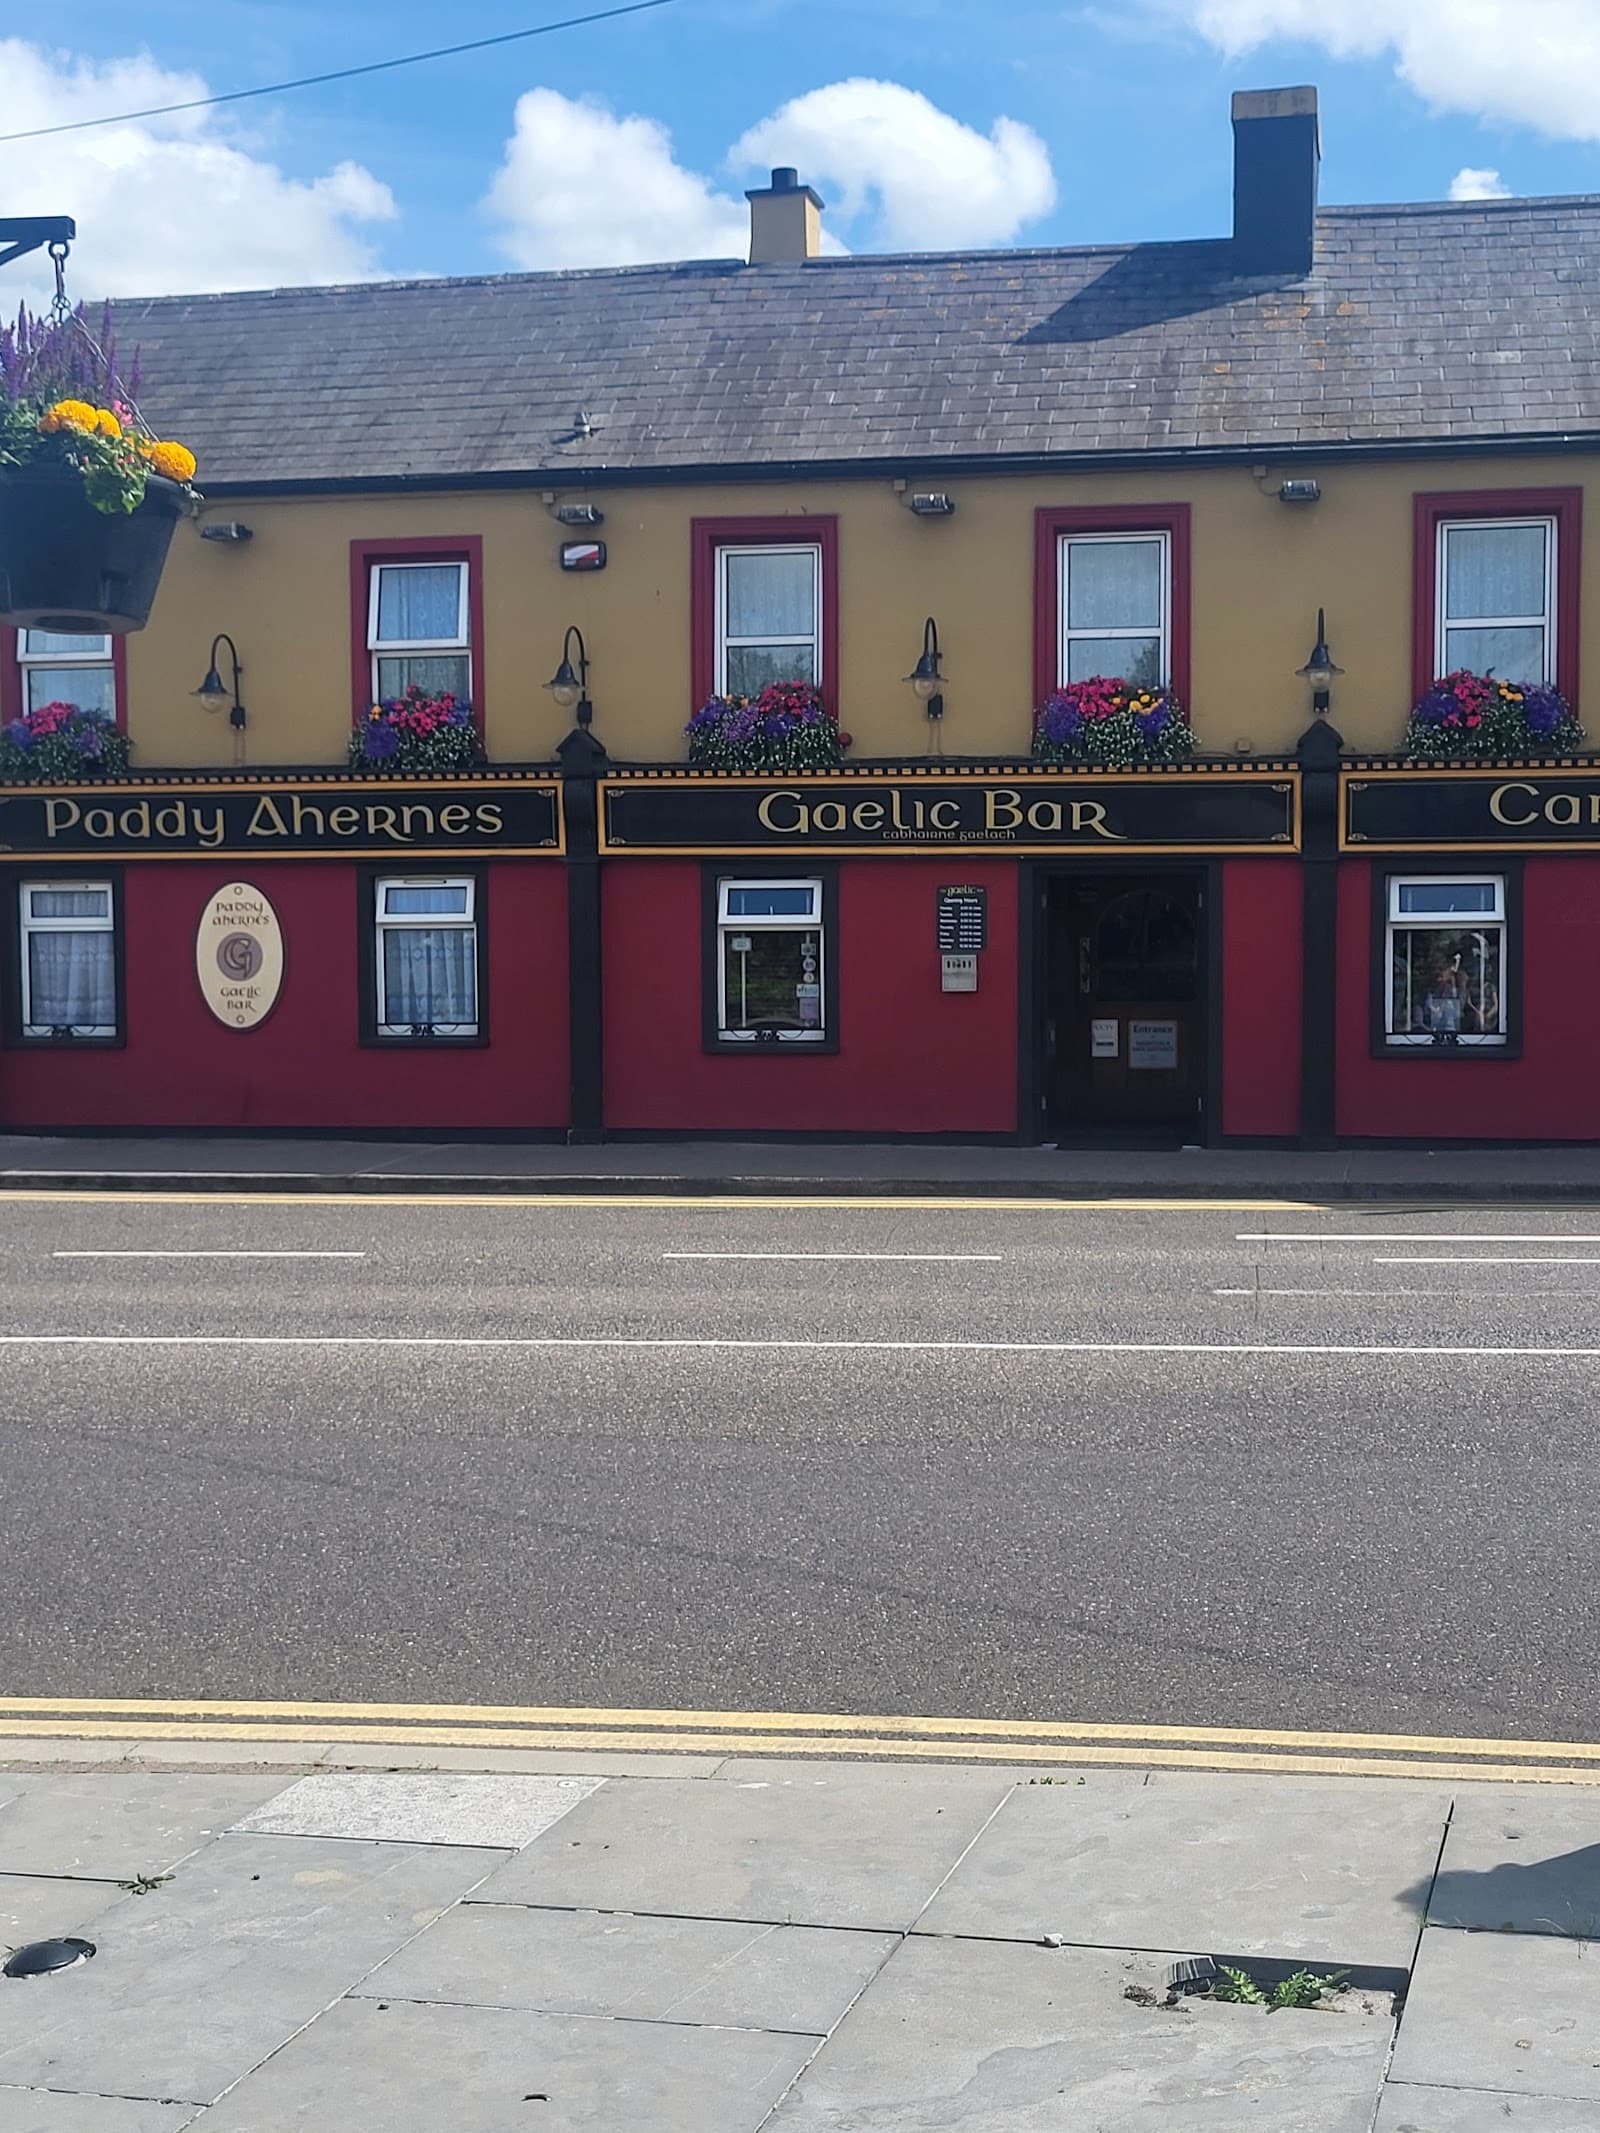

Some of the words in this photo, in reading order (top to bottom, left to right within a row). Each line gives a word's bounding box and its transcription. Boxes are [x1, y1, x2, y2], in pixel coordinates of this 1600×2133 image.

[44, 798, 225, 847] Paddy
[246, 794, 503, 842] Ahernes
[758, 790, 961, 833] Gaelic
[984, 790, 1128, 839] Bar
